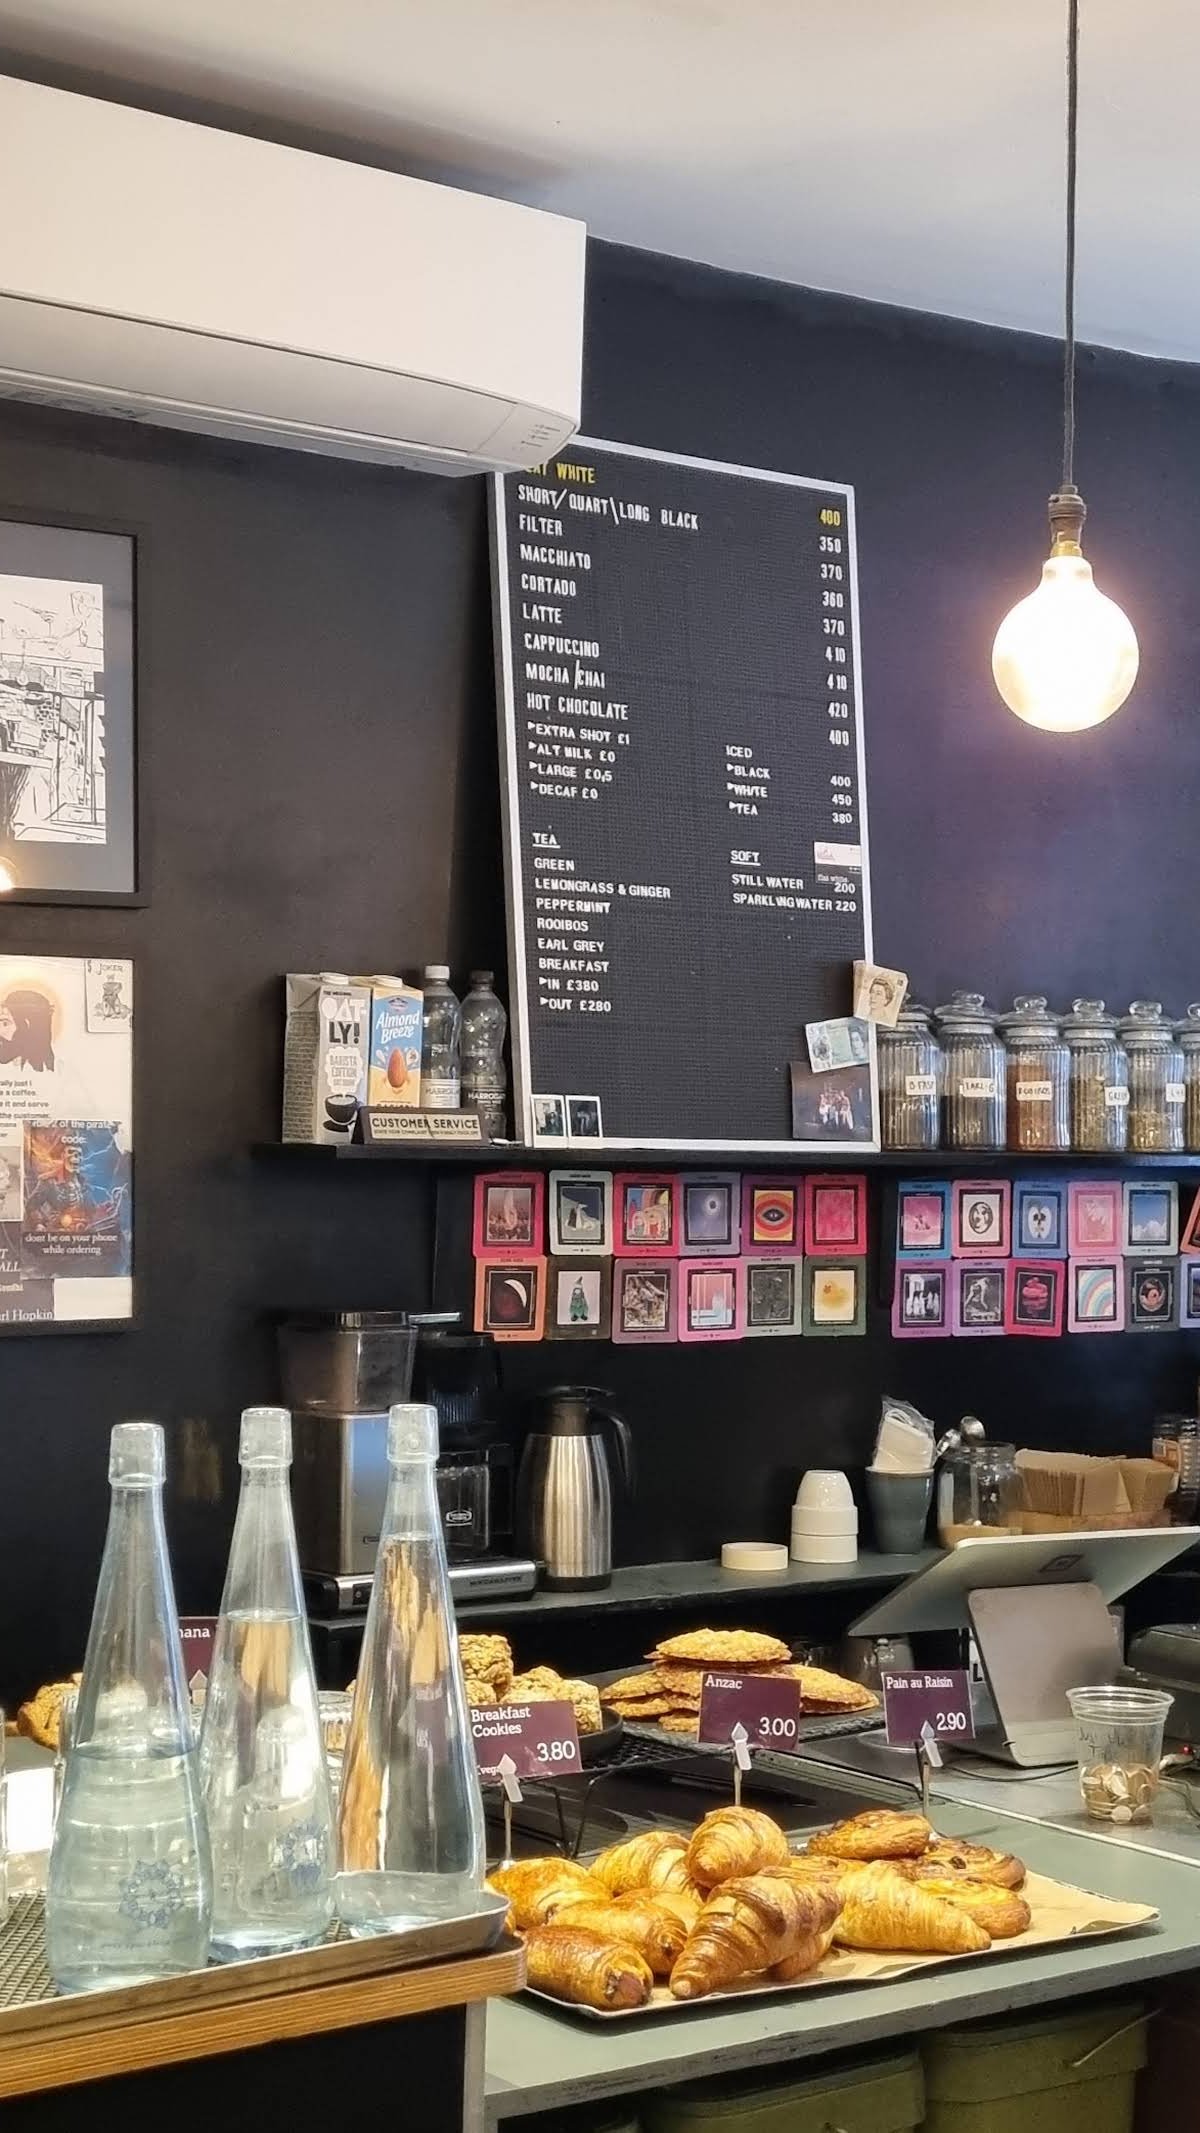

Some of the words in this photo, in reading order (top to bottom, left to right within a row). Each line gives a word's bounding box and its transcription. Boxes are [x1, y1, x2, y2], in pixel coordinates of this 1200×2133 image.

[557, 463, 596, 484] WHITE
[519, 514, 563, 536] FILTER
[661, 509, 699, 530] BLACK
[819, 508, 841, 526] 400
[819, 536, 841, 554] 350
[520, 543, 591, 569] MACCHIATO
[820, 563, 843, 581] 370
[521, 573, 576, 597] CORTADO
[822, 591, 844, 609] 360
[522, 602, 563, 624] LATTE
[823, 618, 845, 636] 370
[524, 633, 600, 658] CAPPUCCINO
[825, 646, 846, 663] 410
[525, 662, 569, 684] MOCHA
[827, 673, 847, 691] 410
[527, 692, 551, 711] HOT
[558, 696, 628, 720] CHOCOLATE
[828, 702, 848, 719] 420
[535, 723, 576, 739] EXTRA
[580, 728, 611, 743] SHOT
[617, 733, 630, 745] £1
[829, 729, 850, 746] 400
[537, 743, 561, 756] ALT
[564, 747, 593, 760] MILK
[726, 745, 752, 758] ICED
[537, 763, 577, 778] LARGE
[734, 765, 771, 779] BLACK
[830, 775, 851, 787] 400
[539, 783, 578, 798] DECAF
[733, 784, 768, 798] WHITE
[831, 794, 852, 806] 450
[736, 803, 758, 815] TEA
[832, 812, 852, 824] 380
[532, 832, 558, 845] TEA
[534, 857, 575, 871] GREEN
[730, 850, 760, 862] SOFT
[535, 878, 614, 894] LEMONGRASS
[618, 884, 627, 895] &
[629, 885, 671, 899] GINGER
[731, 874, 764, 887] STILL
[766, 876, 804, 890] WATER
[834, 882, 856, 894] 200
[536, 897, 611, 914] PEPPERMINT
[733, 893, 795, 909] SPARKLING
[796, 898, 832, 911] WATER
[835, 901, 857, 912] 220
[536, 918, 589, 932] ROOIBOS
[537, 938, 569, 951] EARL
[573, 940, 605, 953] GREY
[538, 957, 610, 973] BREAKFAST
[547, 979, 560, 990] IN
[566, 980, 599, 992] £380
[549, 999, 572, 1010] OUT
[579, 1001, 612, 1012] £280
[376, 1010, 420, 1029] Almond
[329, 1021, 360, 1044] LY!
[381, 1026, 415, 1044] Breeze
[372, 1118, 430, 1129] CUSTOMER
[434, 1119, 478, 1129] SERVICE
[72, 1235, 90, 1244] your
[92, 1233, 118, 1244] phone
[43, 1245, 65, 1254] while
[66, 1245, 101, 1256] ordering
[705, 1674, 743, 1690] Anzac
[886, 1676, 909, 1689] Pain
[910, 1678, 923, 1689] au
[924, 1675, 954, 1688] Raisin
[471, 1706, 532, 1722] Breakfast
[936, 1711, 967, 1731] 2.90
[472, 1723, 522, 1738] Cookies
[759, 1717, 796, 1737] 3.00
[537, 1740, 576, 1762] 3.80
